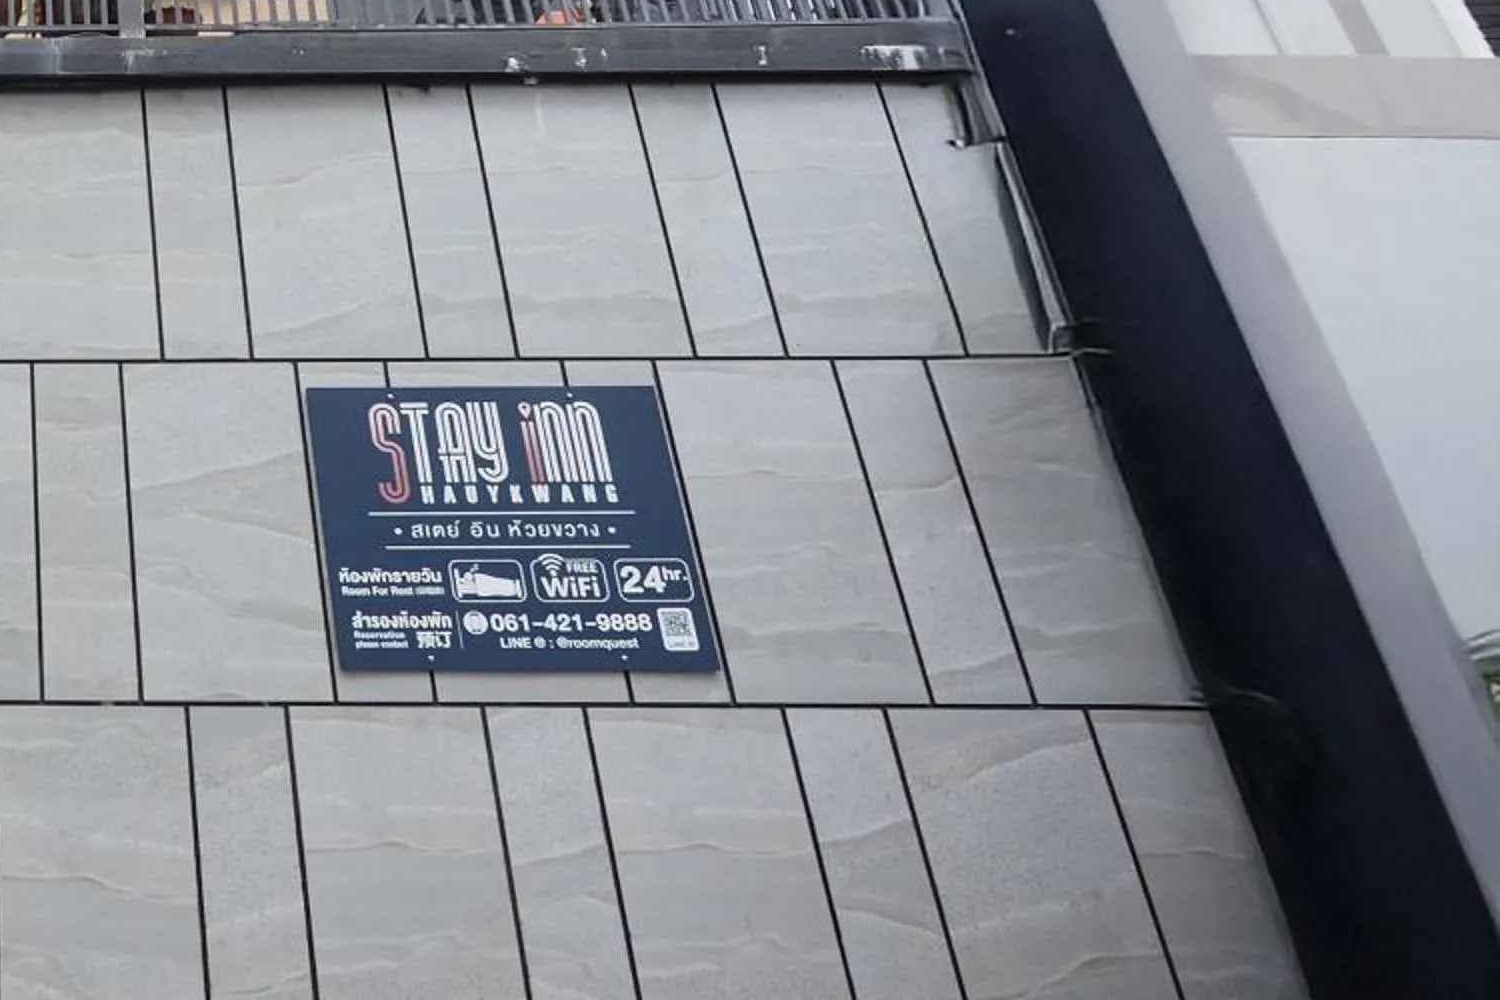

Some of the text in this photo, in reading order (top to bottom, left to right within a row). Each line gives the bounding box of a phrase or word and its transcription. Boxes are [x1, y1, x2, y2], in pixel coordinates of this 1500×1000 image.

[419, 484, 619, 505] HAUYKWANG
[470, 519, 500, 539] อิน
[507, 519, 601, 539] ห้วยขวาง
[339, 567, 443, 584] ห้องพักรายวัน
[564, 559, 599, 574] FREE
[341, 586, 371, 596] Room
[372, 586, 389, 596] For
[539, 576, 602, 599] WiFi
[351, 609, 453, 630] สำรองห้องพัก
[489, 611, 654, 633] 061-421-9888
[500, 637, 533, 650] LINE
[555, 637, 640, 652] @roomquest
